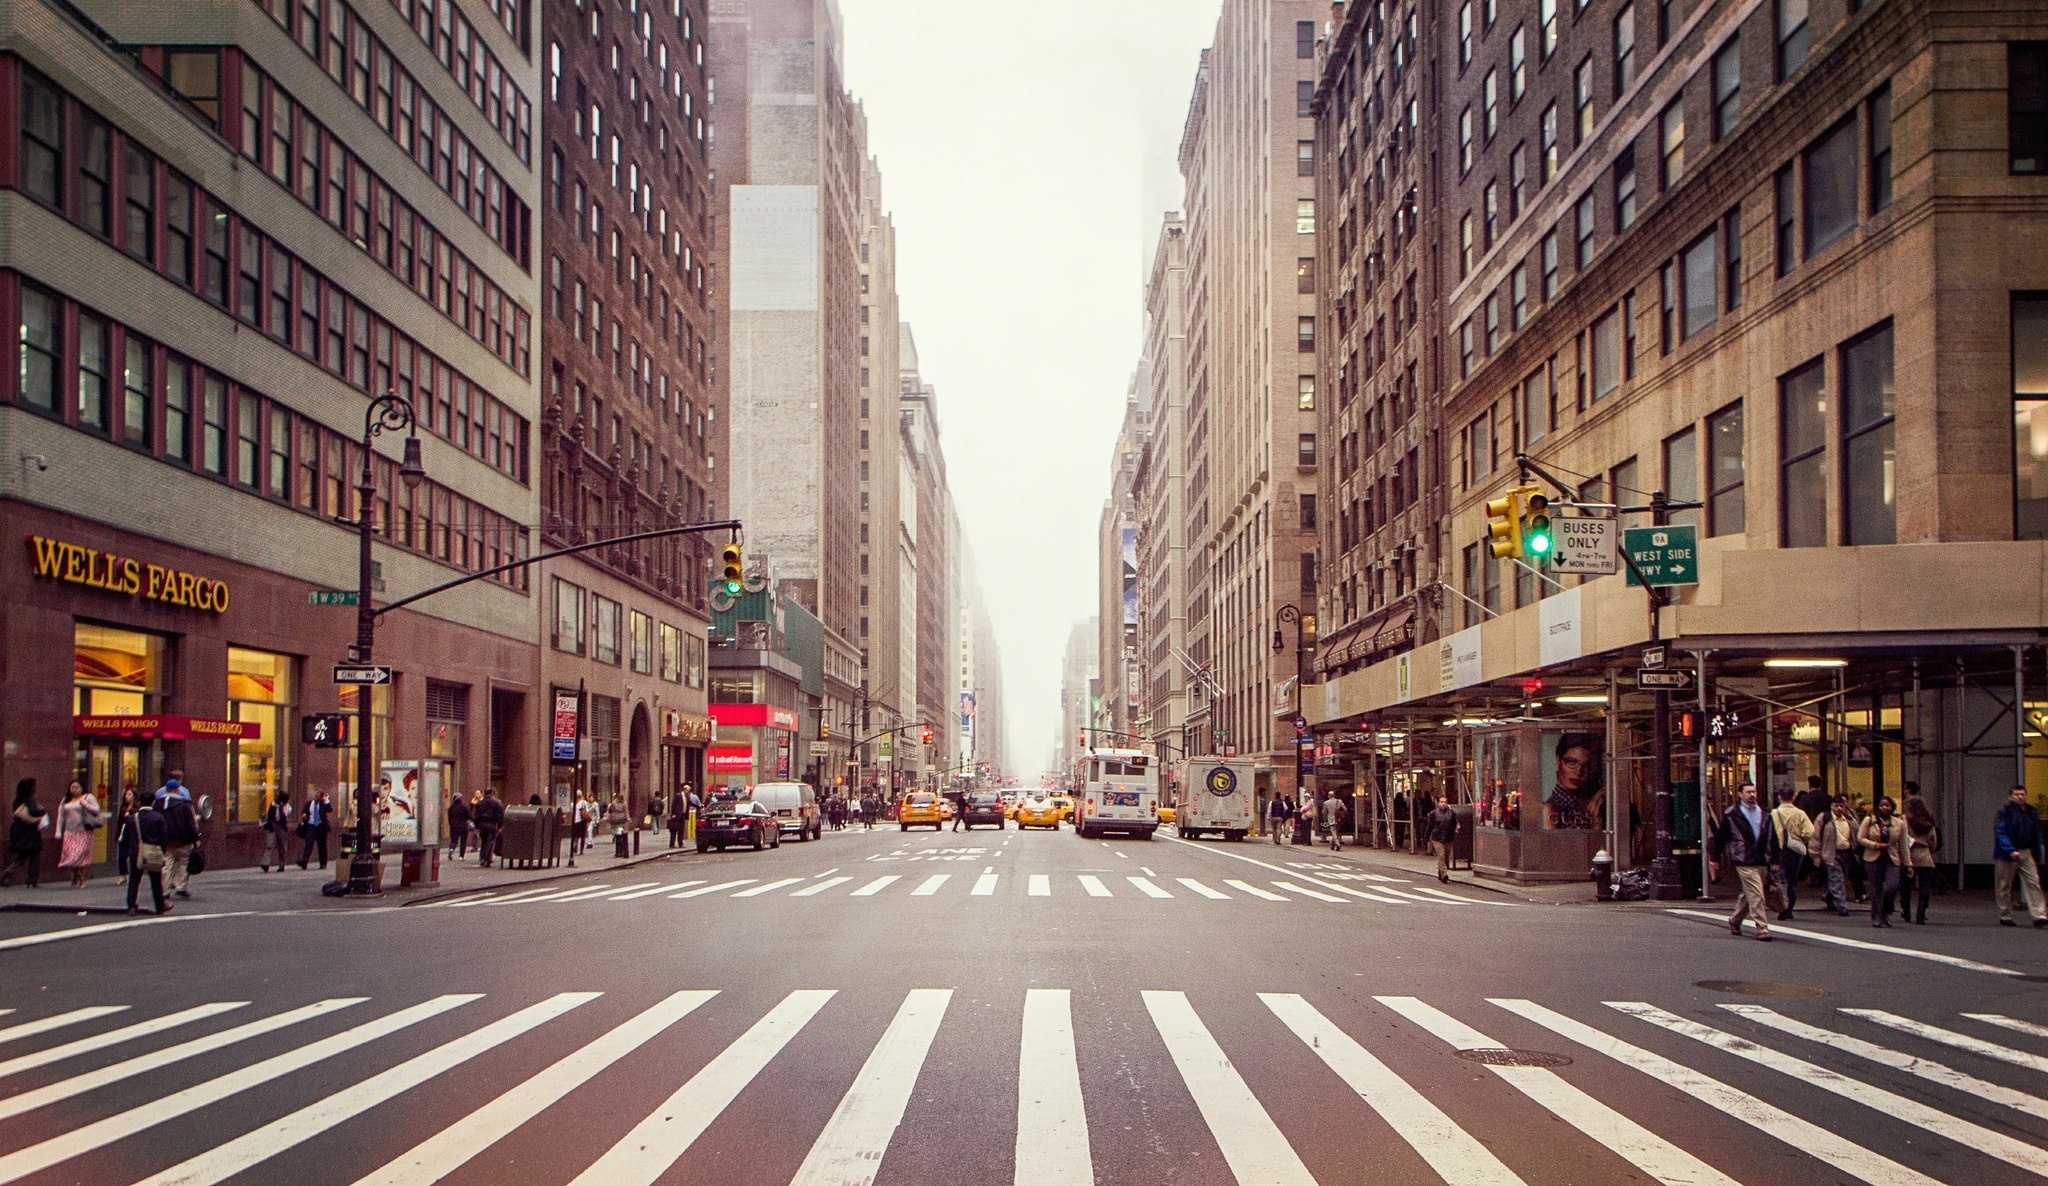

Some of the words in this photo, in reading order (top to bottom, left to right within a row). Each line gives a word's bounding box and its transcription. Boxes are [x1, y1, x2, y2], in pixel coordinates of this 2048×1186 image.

[1563, 522, 1604, 534] BUSES
[1567, 537, 1600, 549] ONLY
[1654, 535, 1666, 544] 9A
[1633, 550, 1662, 562] WEST
[1667, 548, 1692, 560] SIDE
[33, 535, 140, 595] WELLS
[146, 563, 230, 614] FARGO
[1638, 565, 1662, 576] HWY
[331, 591, 346, 603] 39
[341, 670, 357, 679] ONE
[365, 671, 382, 679] WAY
[1646, 675, 1662, 683] ONE
[1669, 675, 1684, 684] WAY
[82, 719, 120, 729] WELLS
[122, 719, 159, 729] FARGO
[190, 720, 217, 733] WELLS
